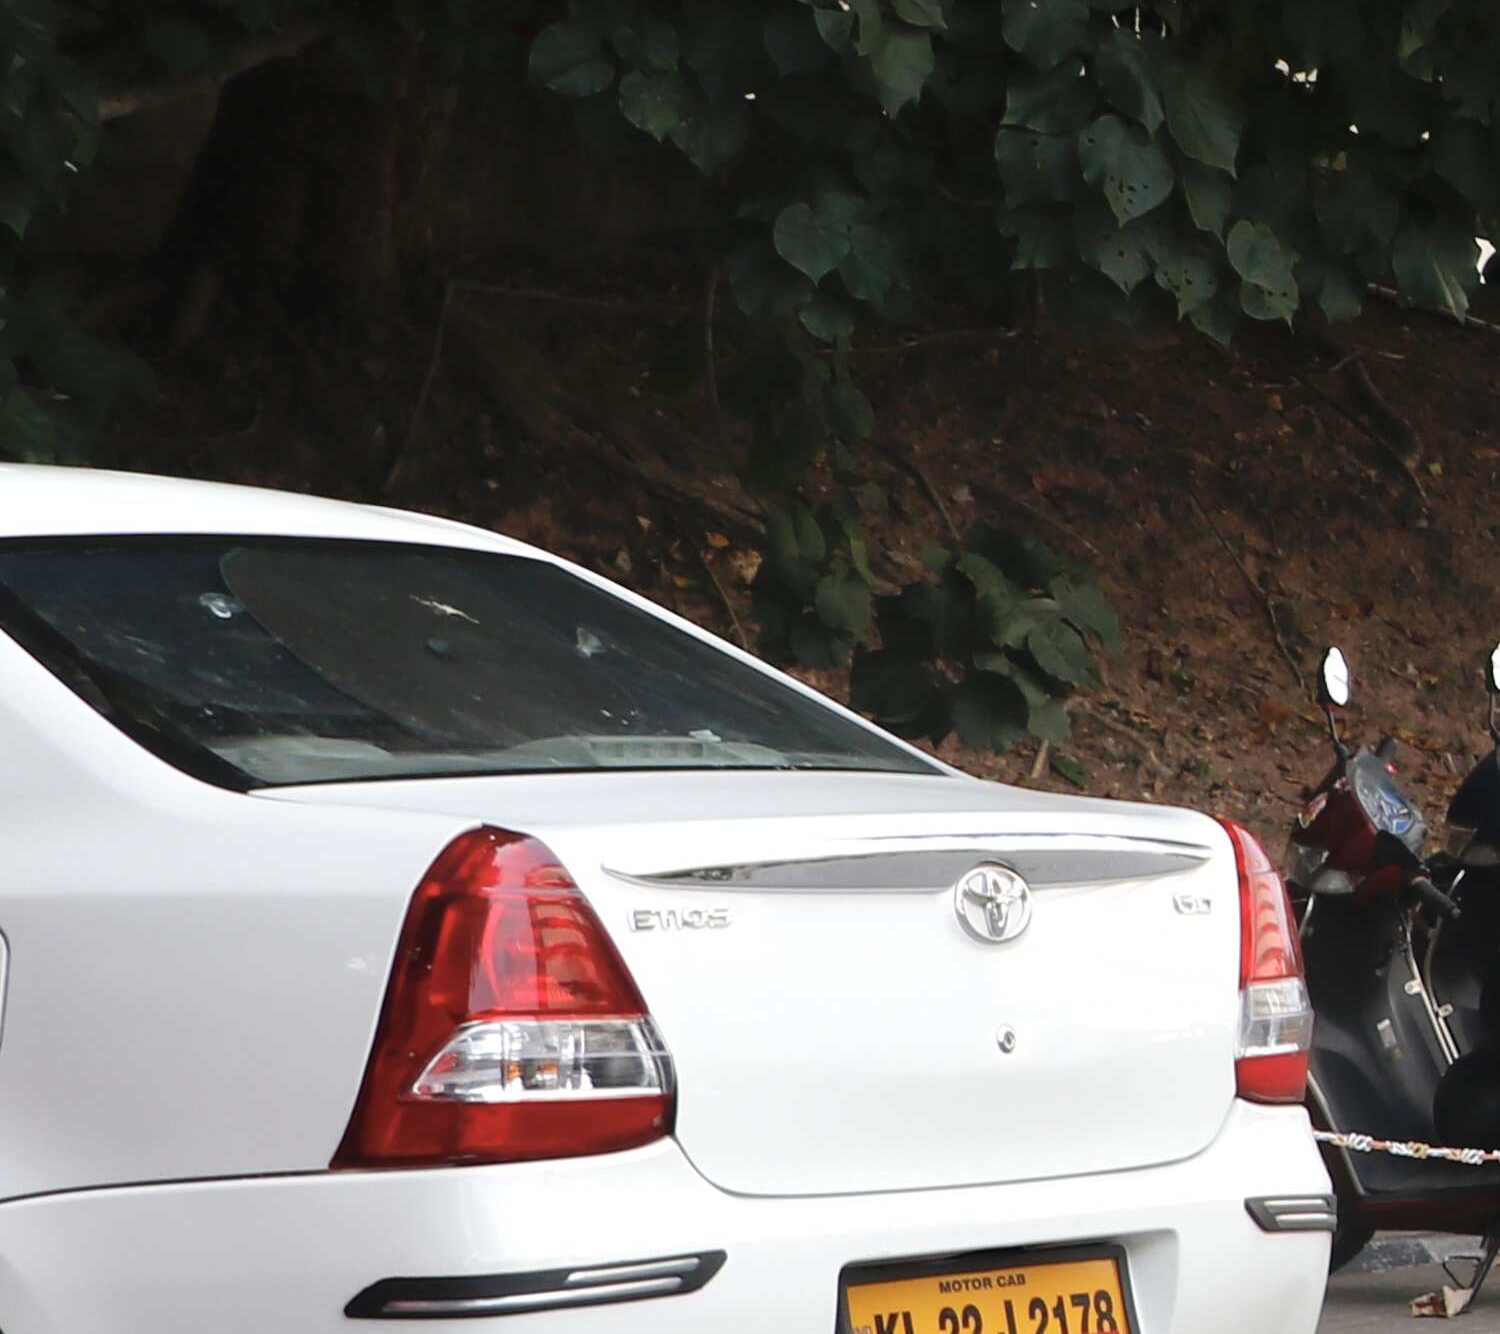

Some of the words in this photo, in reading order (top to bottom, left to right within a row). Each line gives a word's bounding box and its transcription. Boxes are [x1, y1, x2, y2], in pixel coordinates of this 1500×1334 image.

[626, 907, 733, 933] ETIOS
[939, 1276, 993, 1294] MOTOR
[996, 1273, 1027, 1290] CAB
